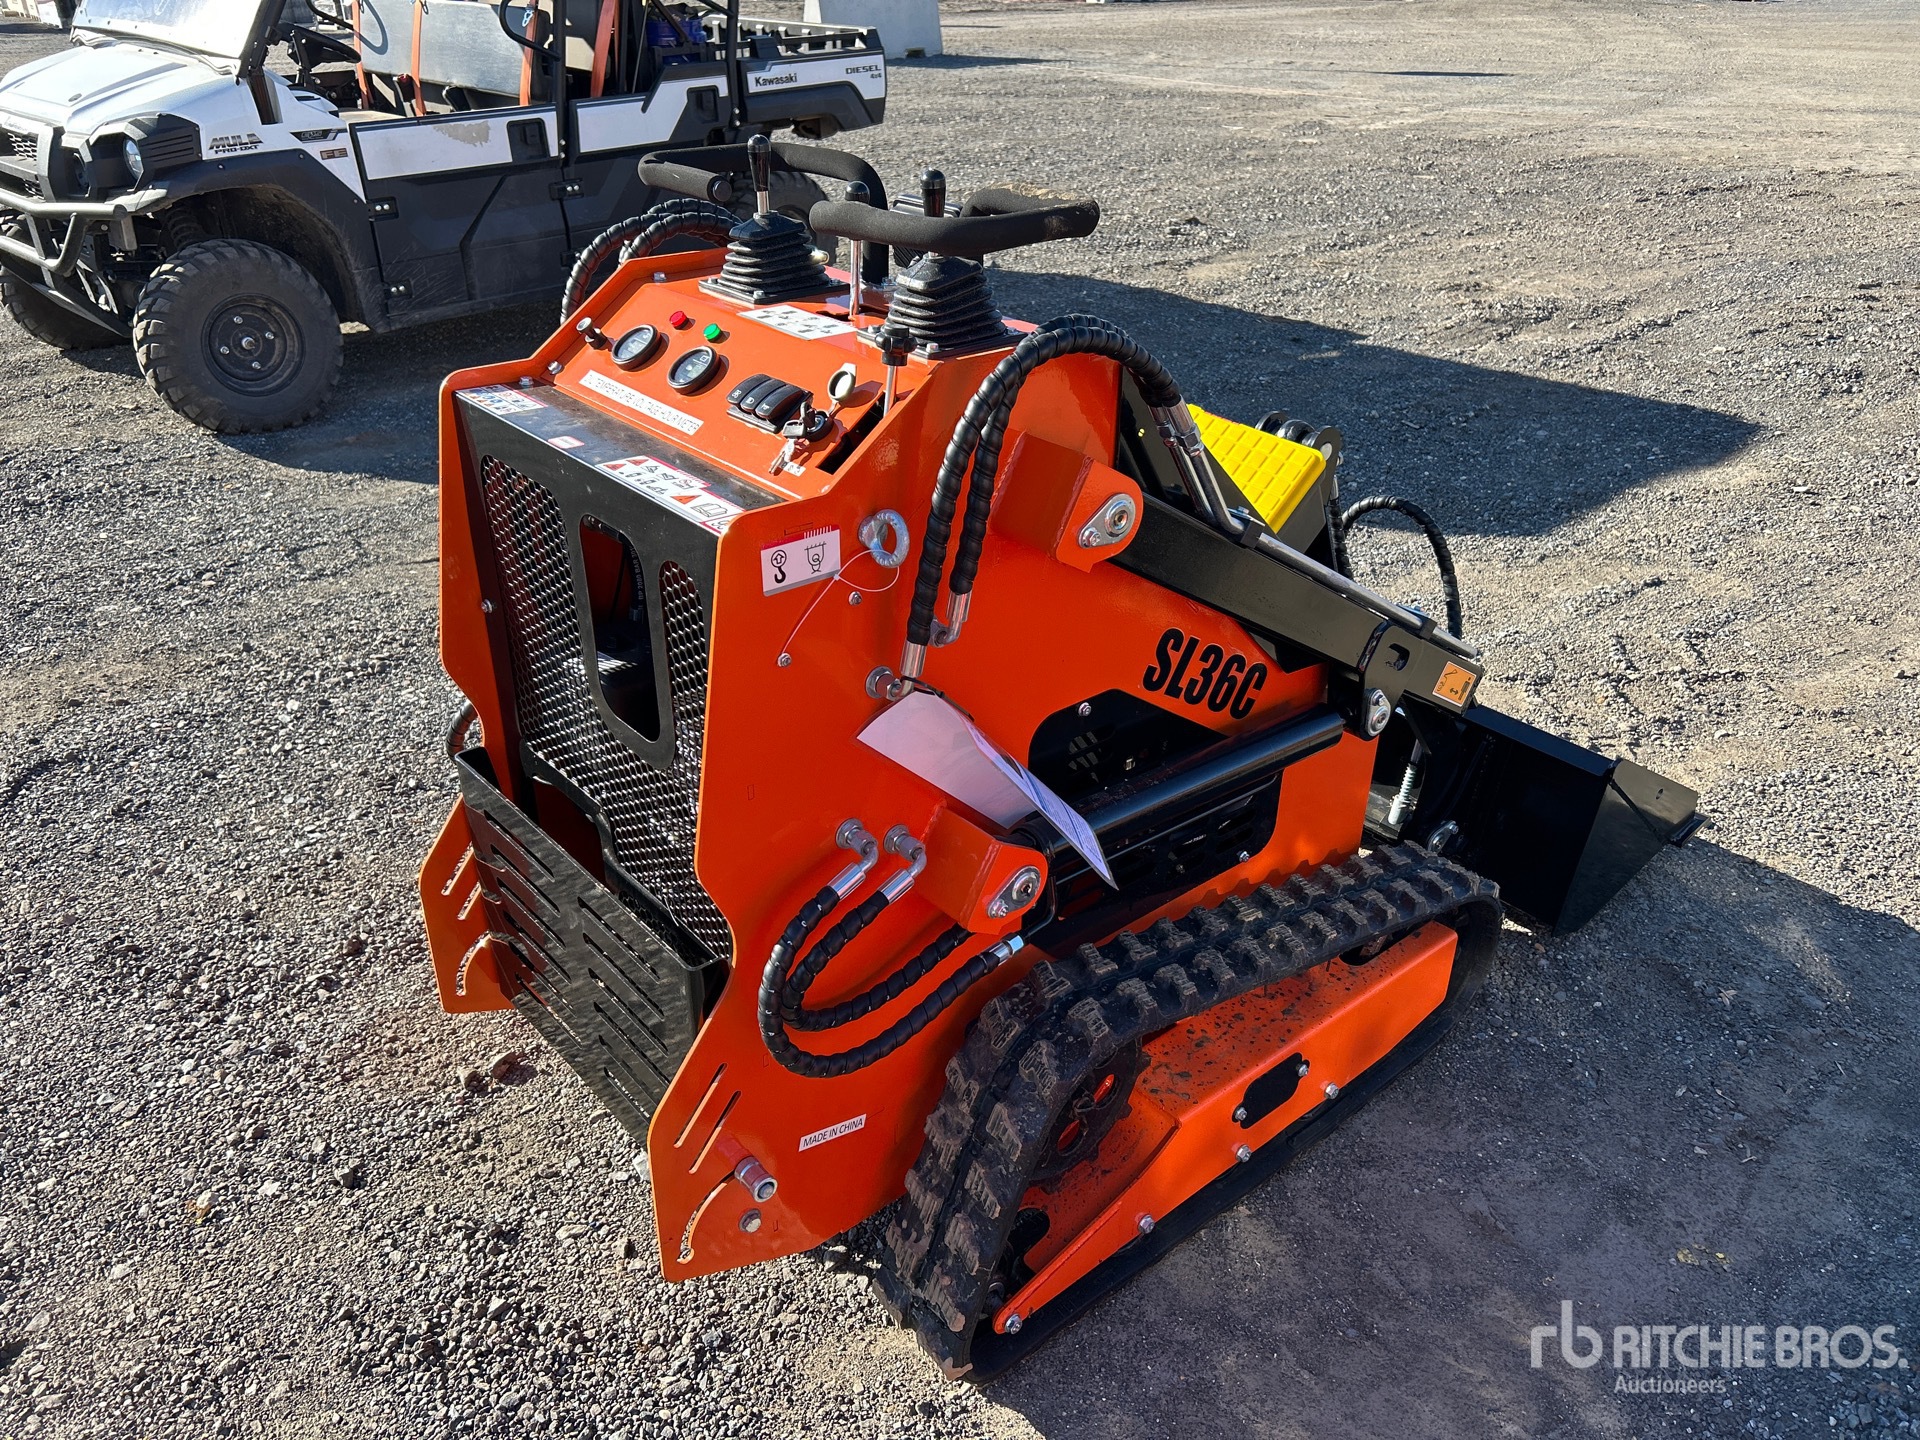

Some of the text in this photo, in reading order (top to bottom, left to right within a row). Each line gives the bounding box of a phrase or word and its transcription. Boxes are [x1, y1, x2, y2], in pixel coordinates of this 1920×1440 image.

[845, 64, 881, 75] DIESEL
[755, 73, 797, 87] Kawasaki
[214, 144, 260, 154] PRO-DXT
[321, 149, 347, 160] FE
[1142, 627, 1267, 719] SL36C
[803, 1118, 863, 1147] MADE IN CHINA
